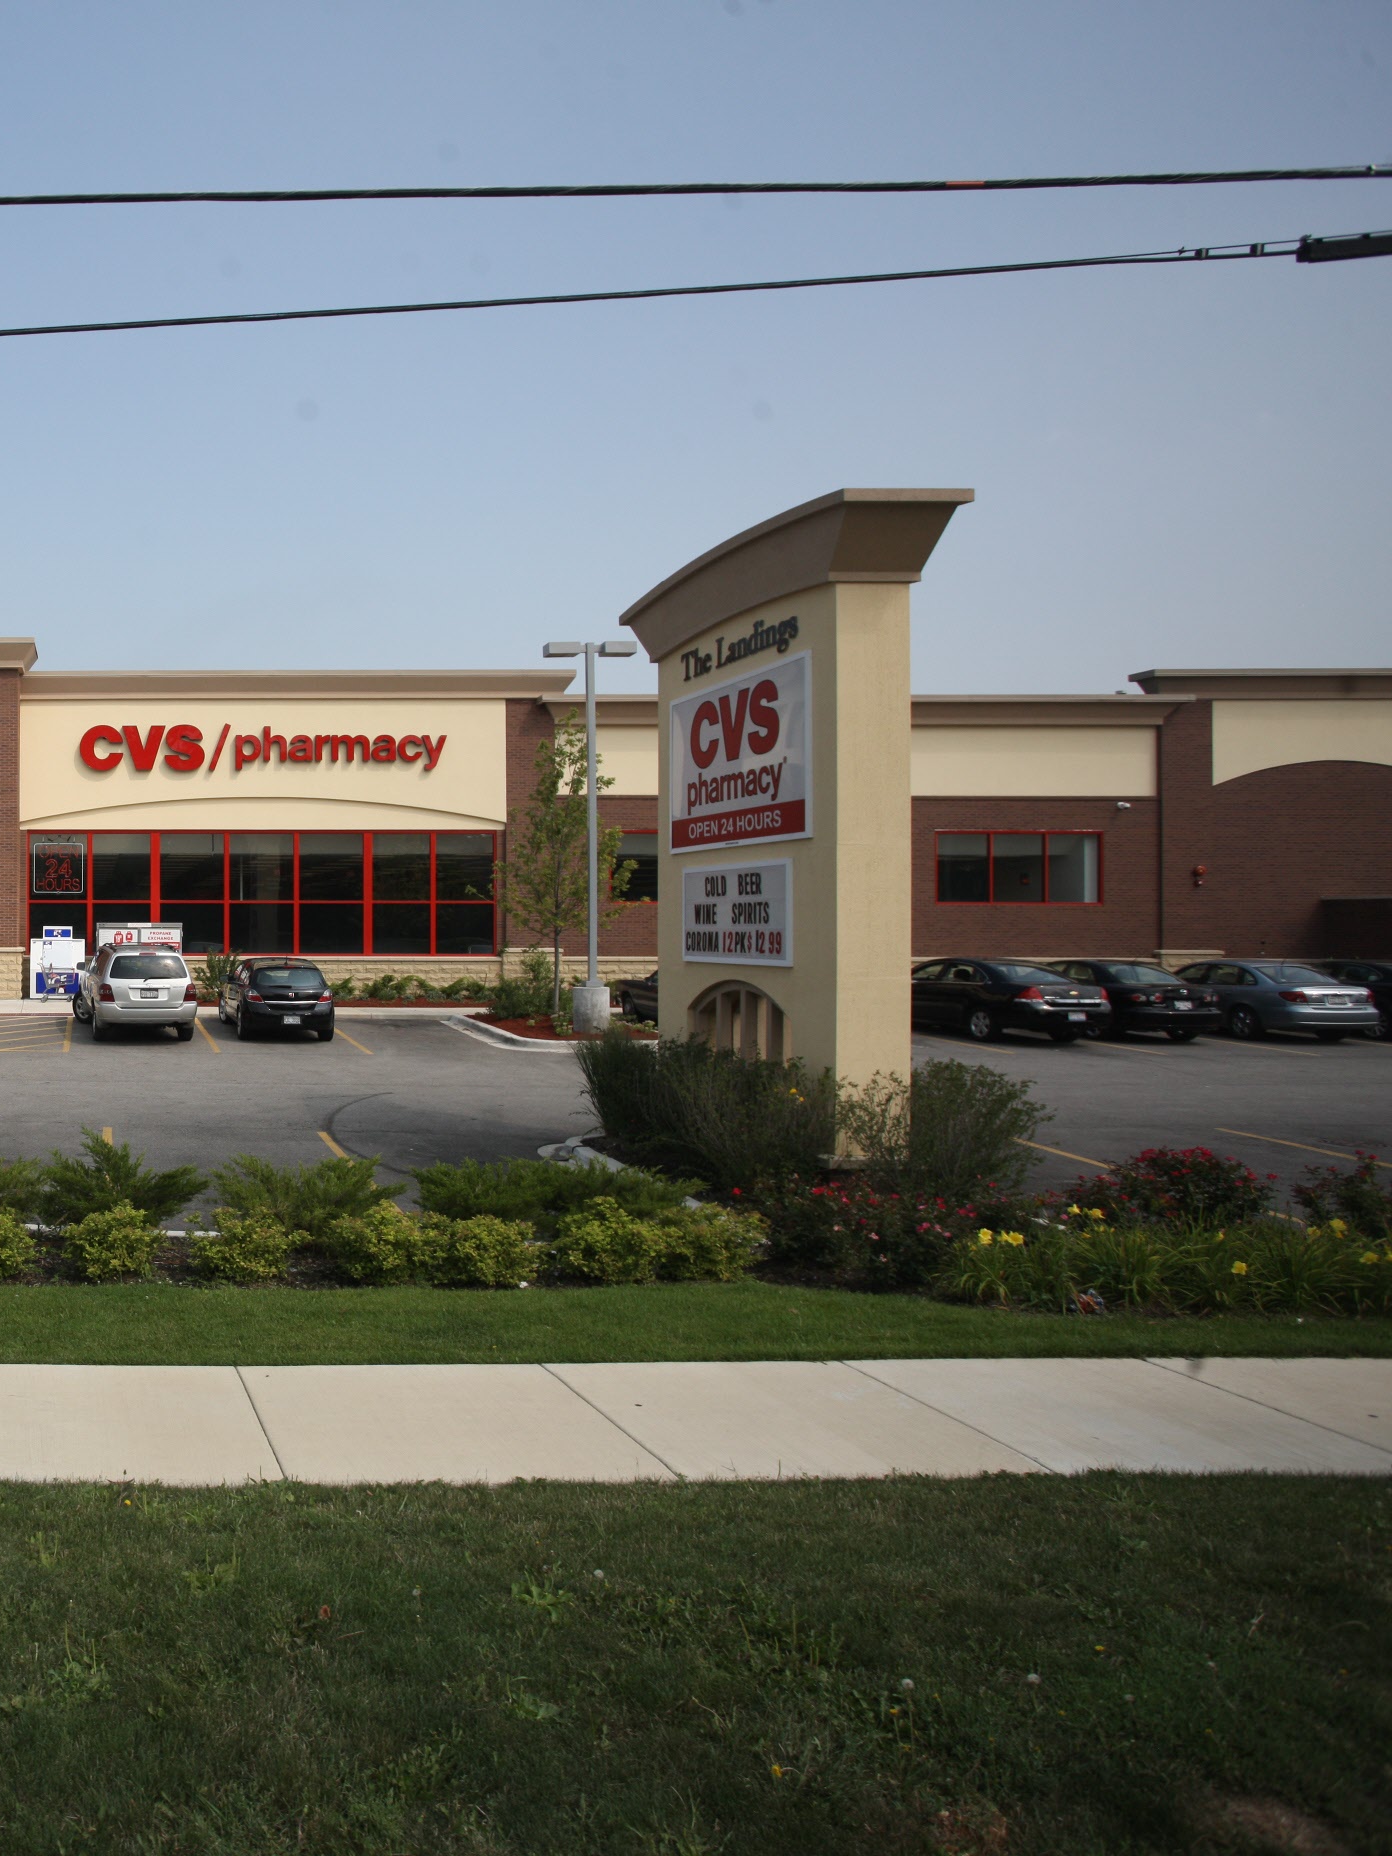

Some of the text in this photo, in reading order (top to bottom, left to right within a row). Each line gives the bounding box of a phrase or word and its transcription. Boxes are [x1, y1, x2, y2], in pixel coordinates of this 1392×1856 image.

[681, 616, 799, 682] The Landings
[690, 679, 780, 769] CVS
[687, 762, 783, 816] pharmacy
[688, 810, 782, 839] OPEN 24 HOURS
[39, 845, 79, 858] OPEN
[45, 858, 73, 878] 24
[36, 878, 80, 891] HOURS
[704, 873, 762, 897] COLD BEER
[694, 902, 770, 925] WINE SPIRITS
[685, 931, 719, 952] CORONA
